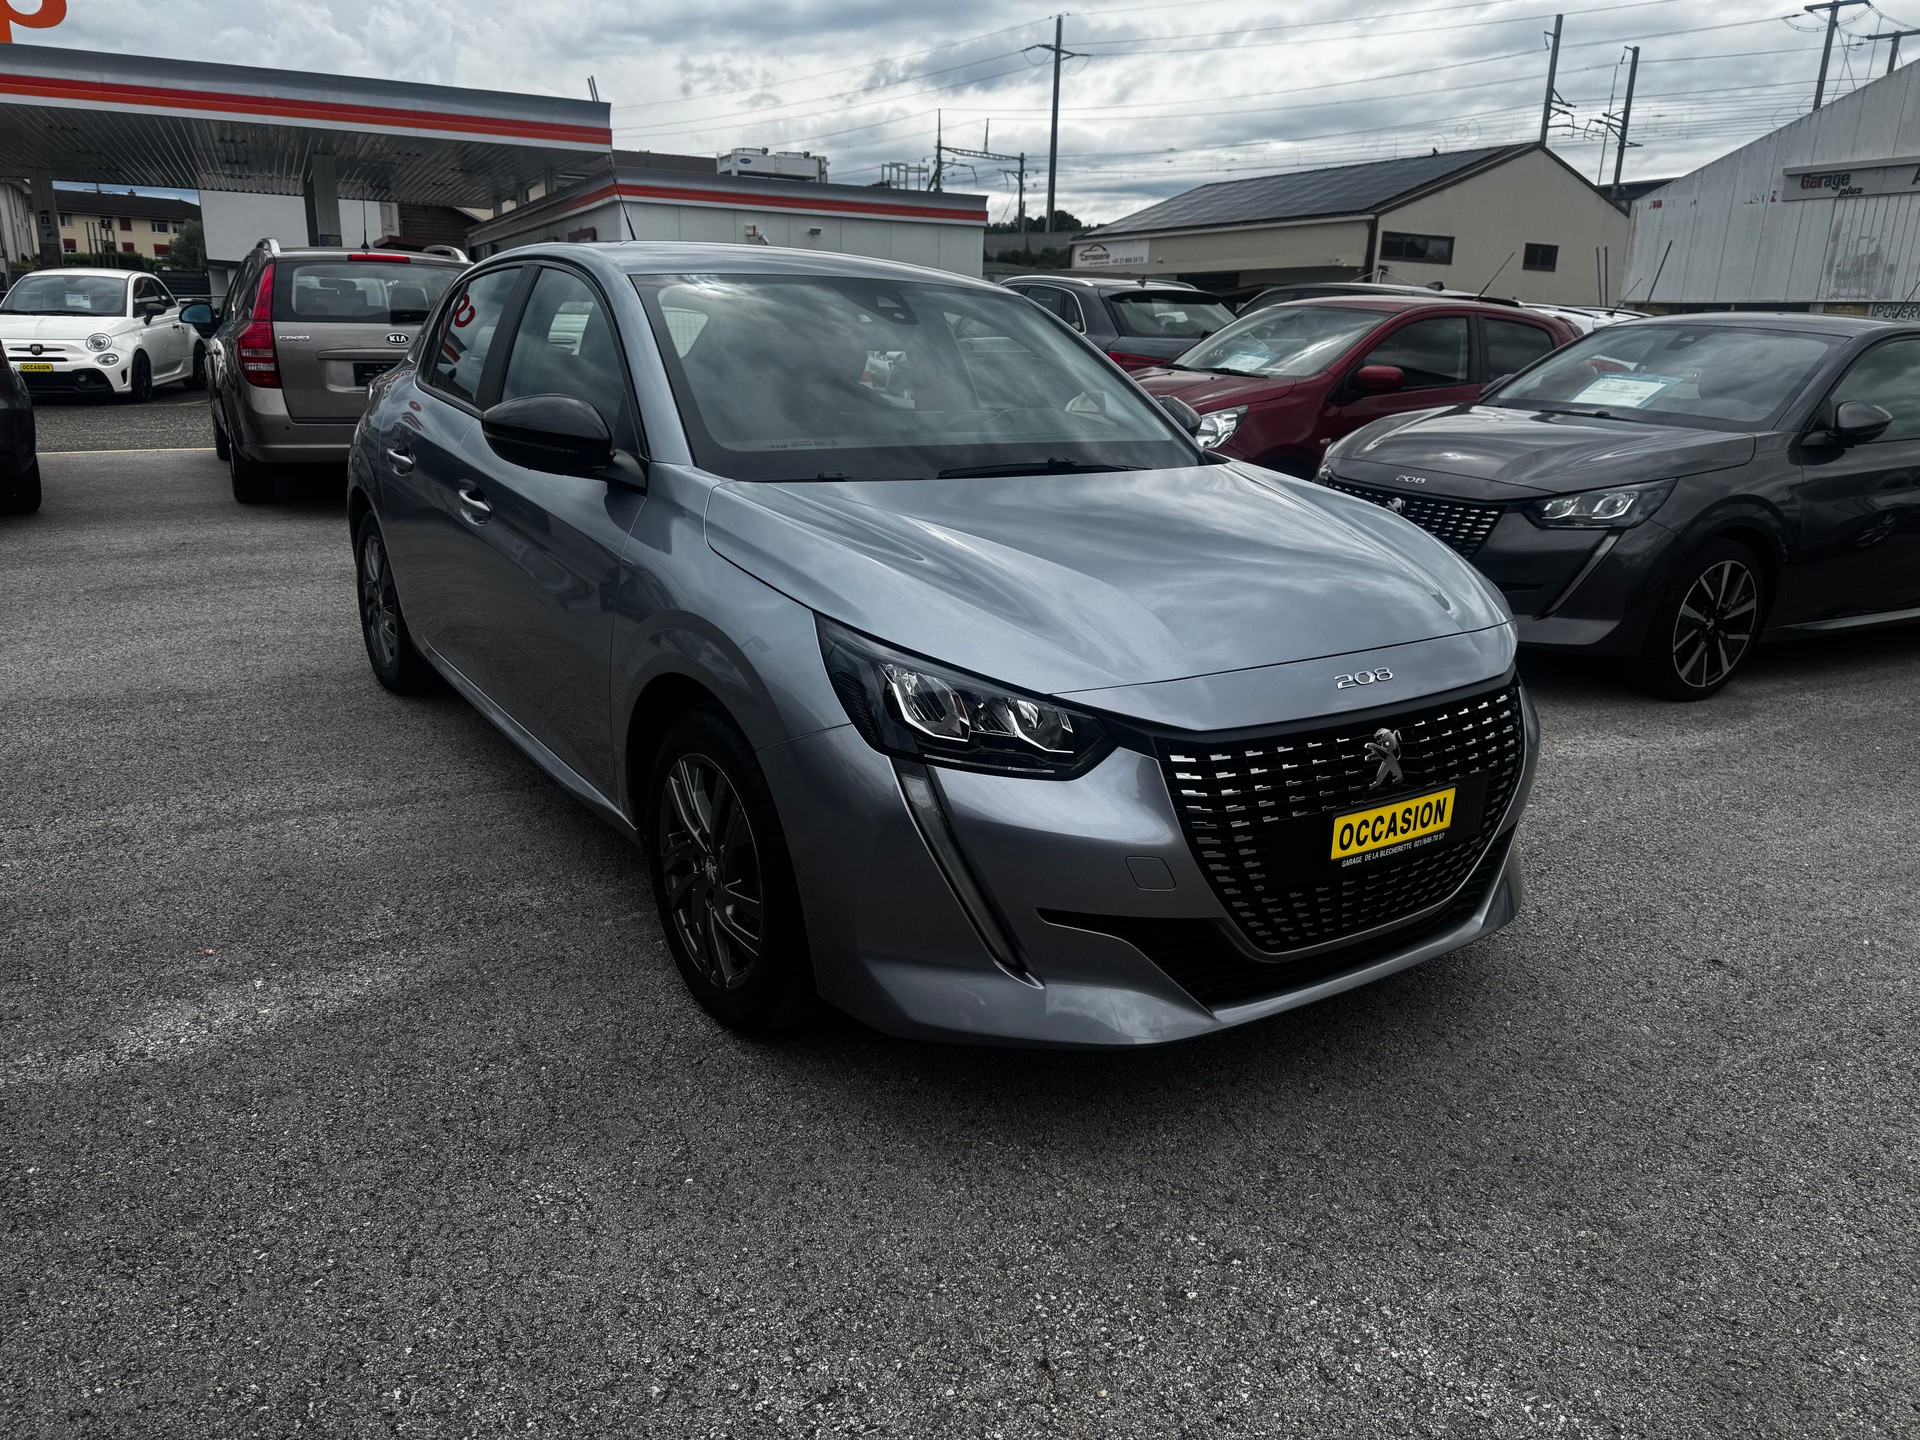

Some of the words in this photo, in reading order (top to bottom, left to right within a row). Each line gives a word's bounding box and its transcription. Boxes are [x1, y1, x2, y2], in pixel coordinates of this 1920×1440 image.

[1801, 173, 1851, 191] Garage
[1838, 186, 1864, 198] plus
[1396, 475, 1426, 484] 208
[1334, 667, 1394, 690] 208
[1339, 797, 1447, 851] OCCASION
[1341, 856, 1363, 868] GARAGE
[1364, 853, 1372, 862] DE
[1372, 851, 1379, 860] LA
[1379, 842, 1413, 858] BLECHERETTE
[1432, 834, 1439, 842] 70
